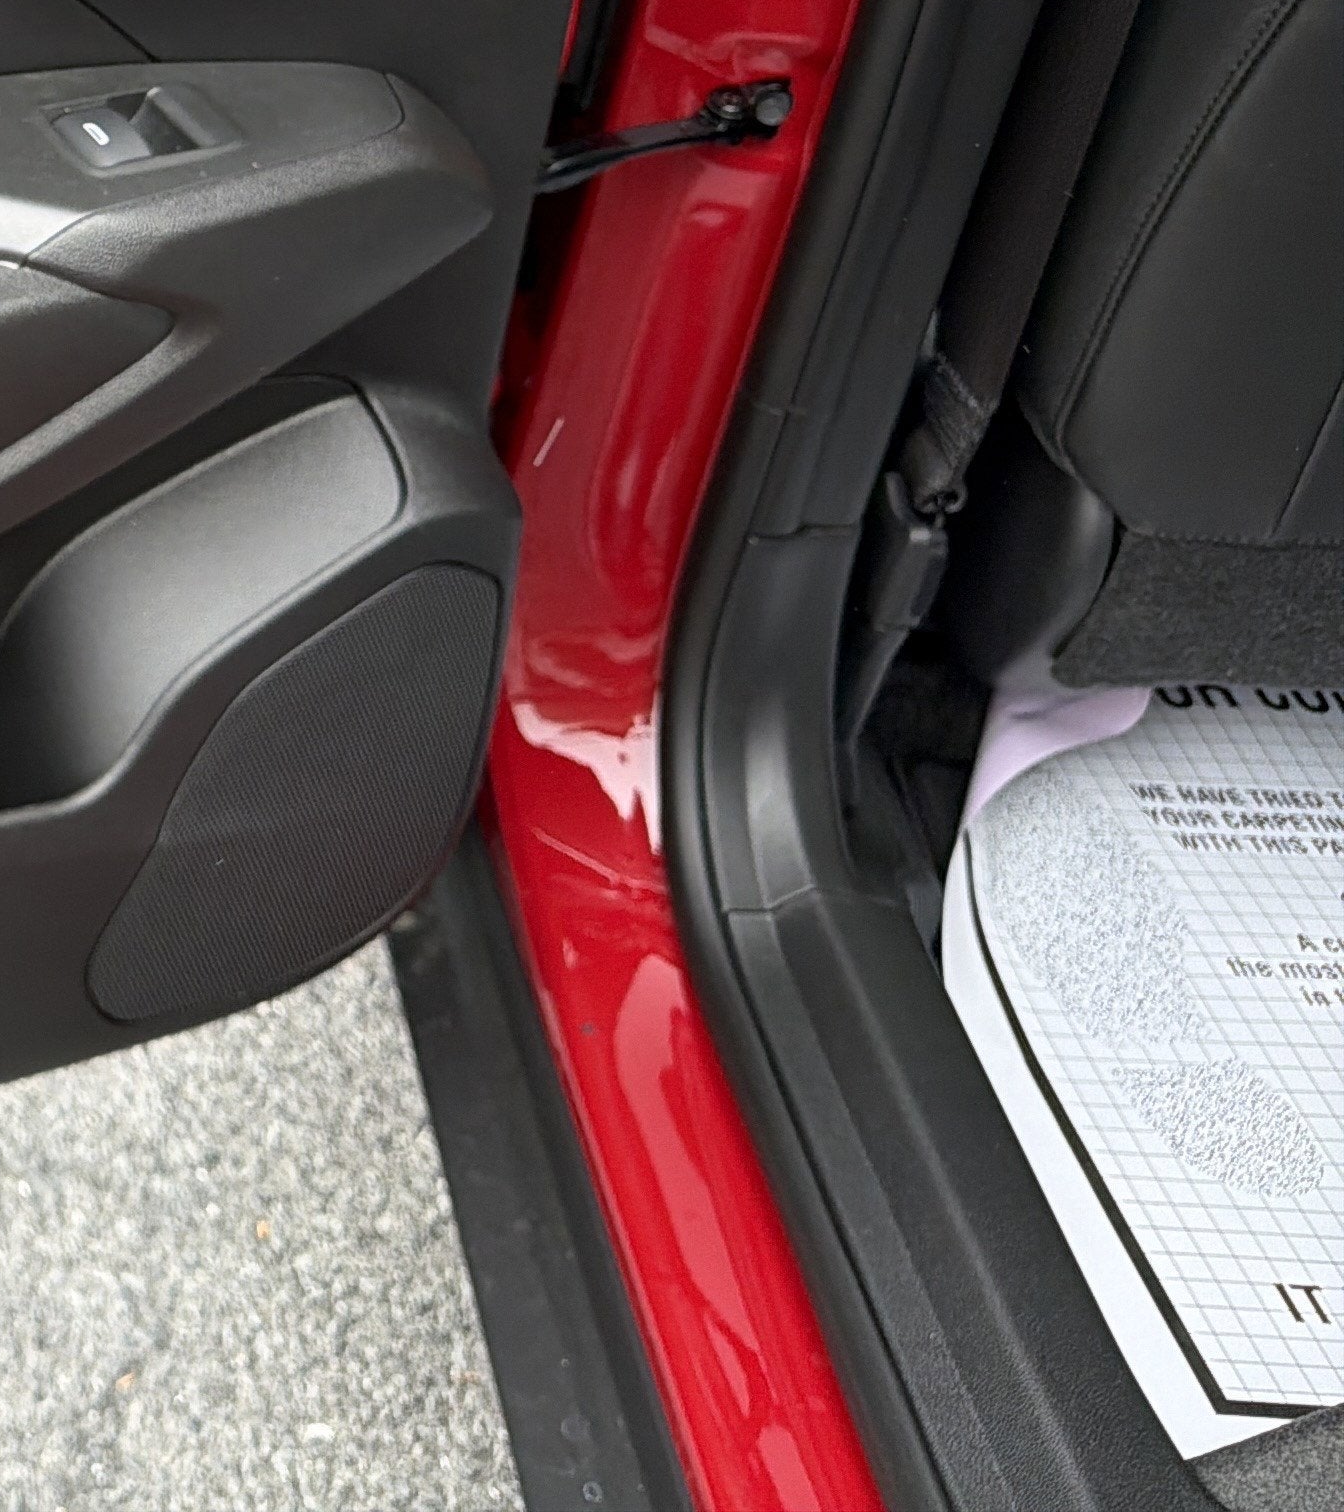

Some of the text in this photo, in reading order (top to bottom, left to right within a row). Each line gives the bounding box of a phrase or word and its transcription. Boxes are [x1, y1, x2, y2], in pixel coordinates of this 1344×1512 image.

[1128, 782, 1174, 803] WE
[1176, 784, 1246, 806] HAVE
[1246, 788, 1325, 809] TRIED
[1141, 805, 1218, 829] YOUR
[1172, 832, 1243, 852] WITH
[1243, 834, 1308, 855] THIS
[1297, 933, 1319, 952] A
[1226, 955, 1272, 977] the
[1299, 985, 1331, 1007] in
[1273, 1283, 1332, 1325] IT
